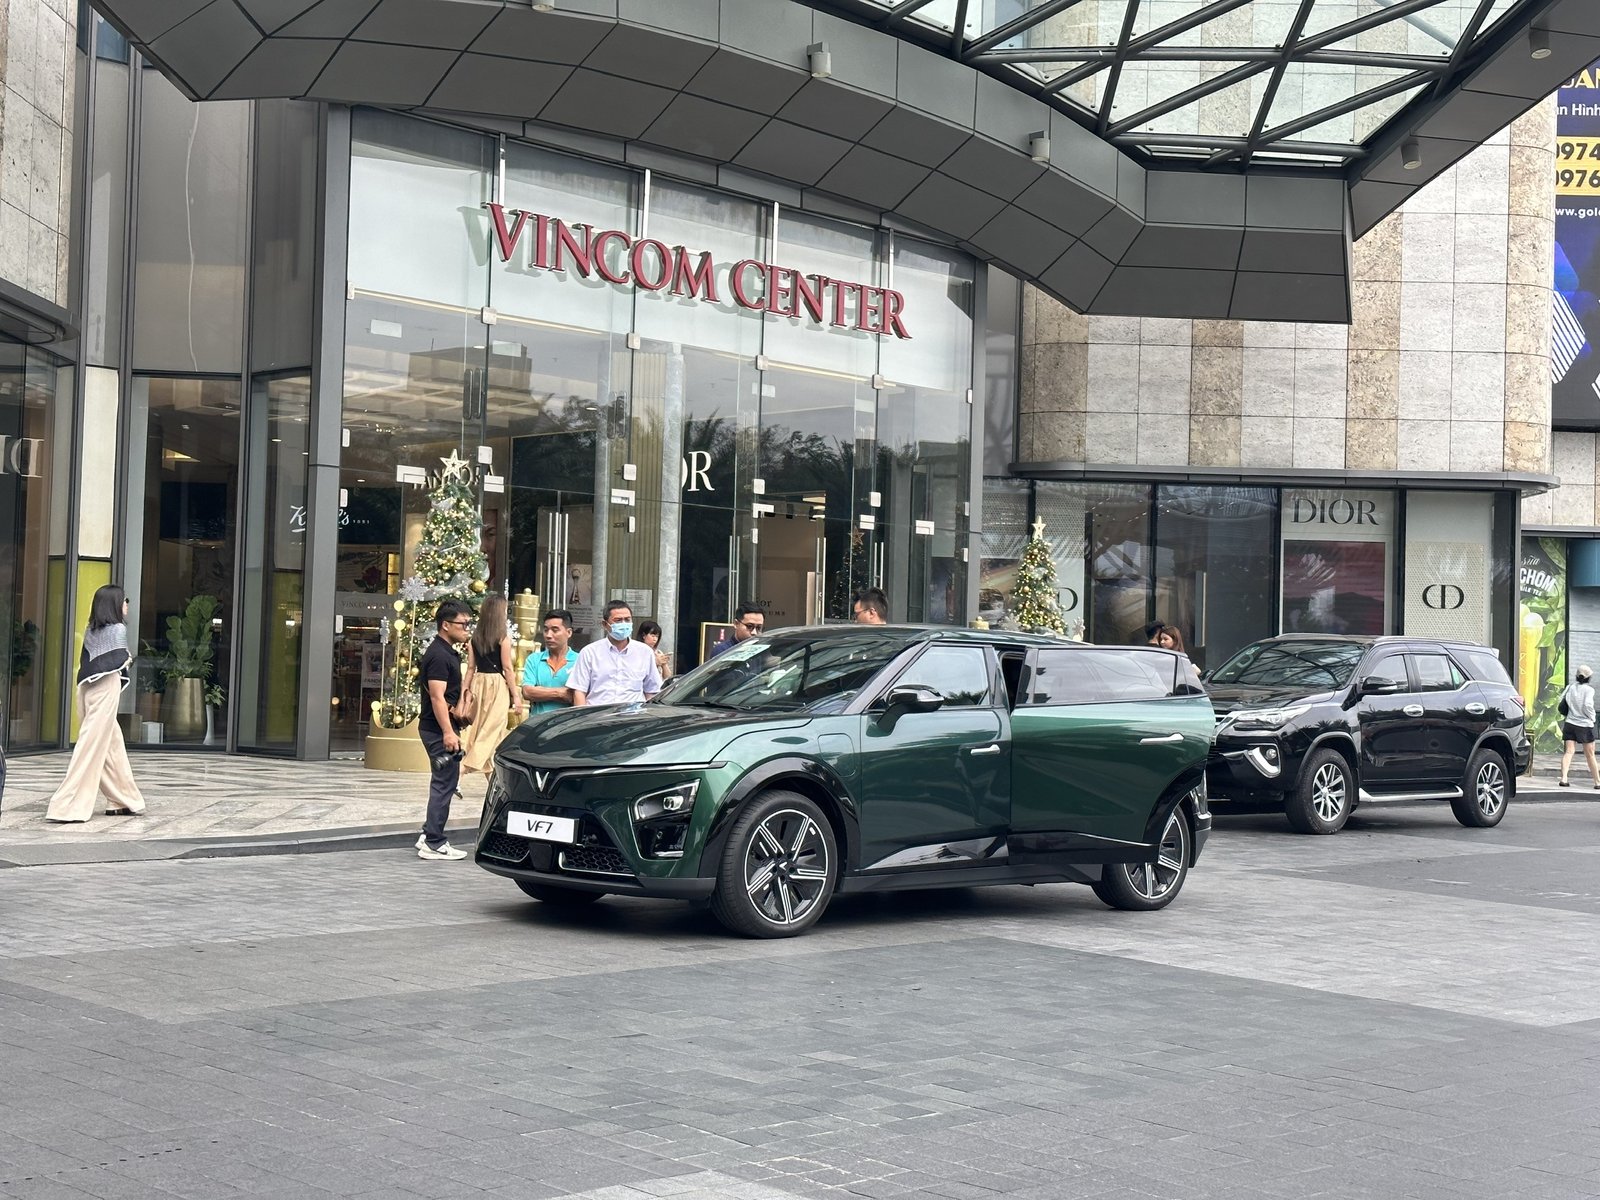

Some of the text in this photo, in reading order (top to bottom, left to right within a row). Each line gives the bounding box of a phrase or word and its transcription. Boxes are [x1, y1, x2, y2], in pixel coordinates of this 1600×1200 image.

[1556, 142, 1600, 160] 974
[1556, 169, 1600, 187] 976
[481, 202, 913, 339] VINCOM CENTER
[1290, 498, 1380, 526] DIOR
[526, 819, 554, 834] VF7
